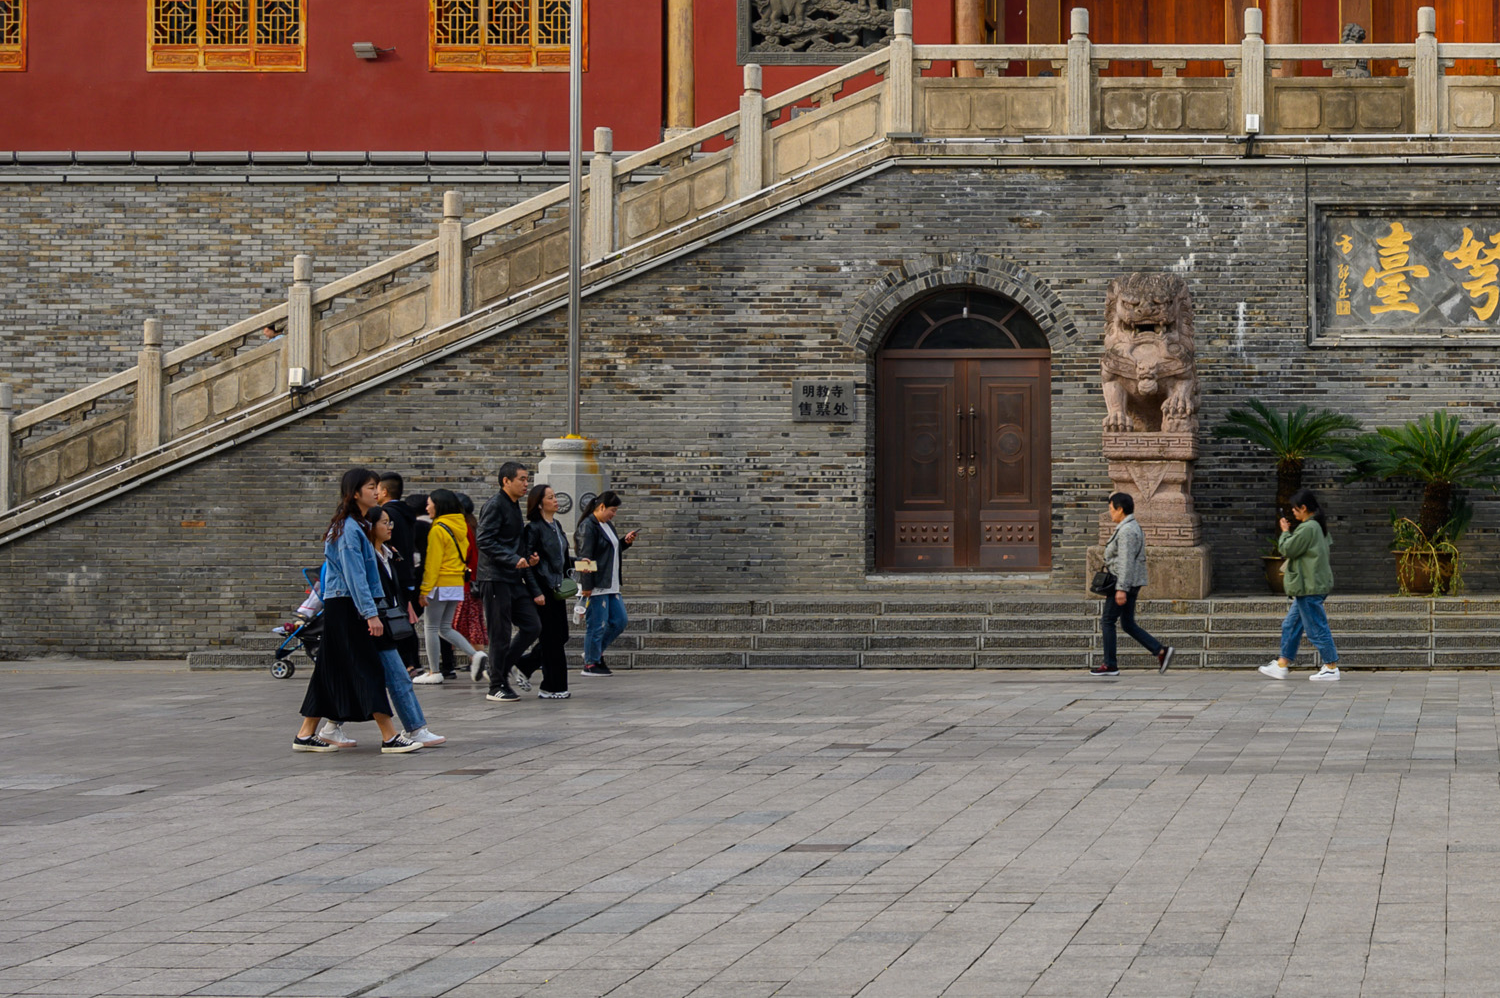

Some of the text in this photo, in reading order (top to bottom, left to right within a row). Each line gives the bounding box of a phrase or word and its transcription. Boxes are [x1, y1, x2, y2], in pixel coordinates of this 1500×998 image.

[802, 385, 843, 398] 明教寺
[798, 402, 848, 417] 售票处
